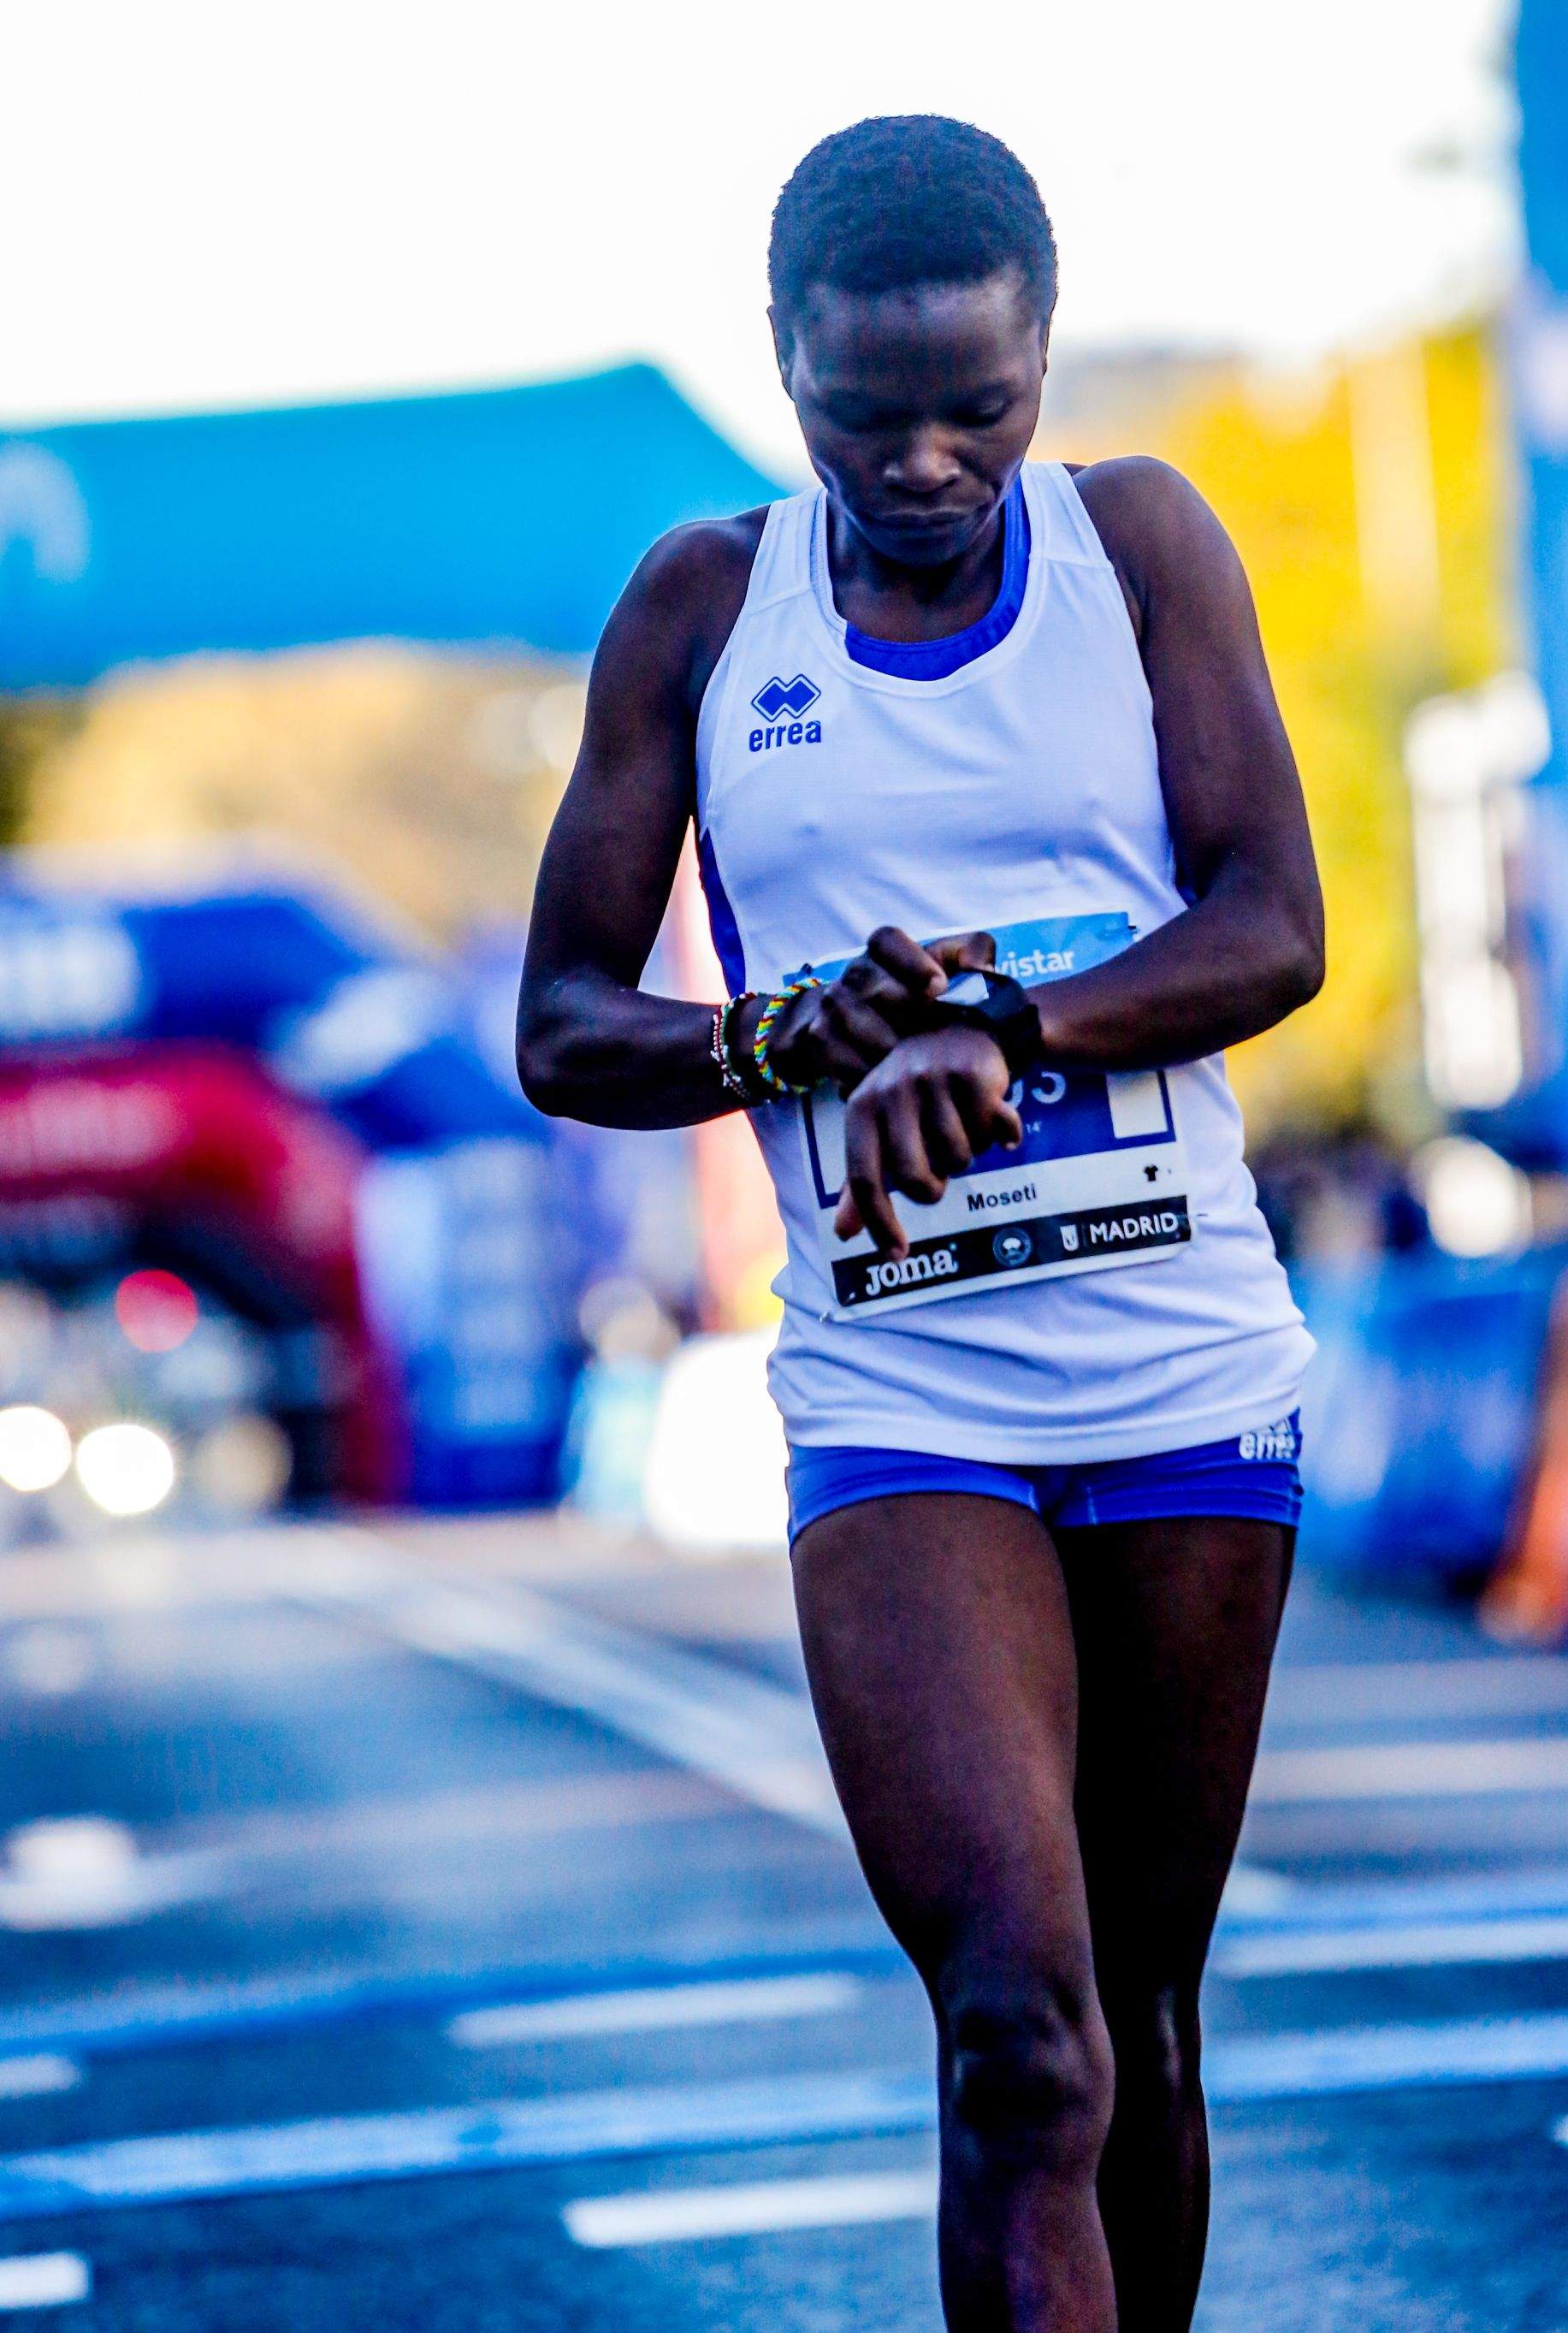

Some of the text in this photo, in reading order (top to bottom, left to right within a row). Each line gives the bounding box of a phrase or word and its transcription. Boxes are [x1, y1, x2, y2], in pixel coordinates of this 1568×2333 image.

[748, 720, 821, 752] errea
[992, 949, 1074, 980] vistar
[967, 1183, 1037, 1211] Moseti
[1089, 1211, 1179, 1244] MADRID
